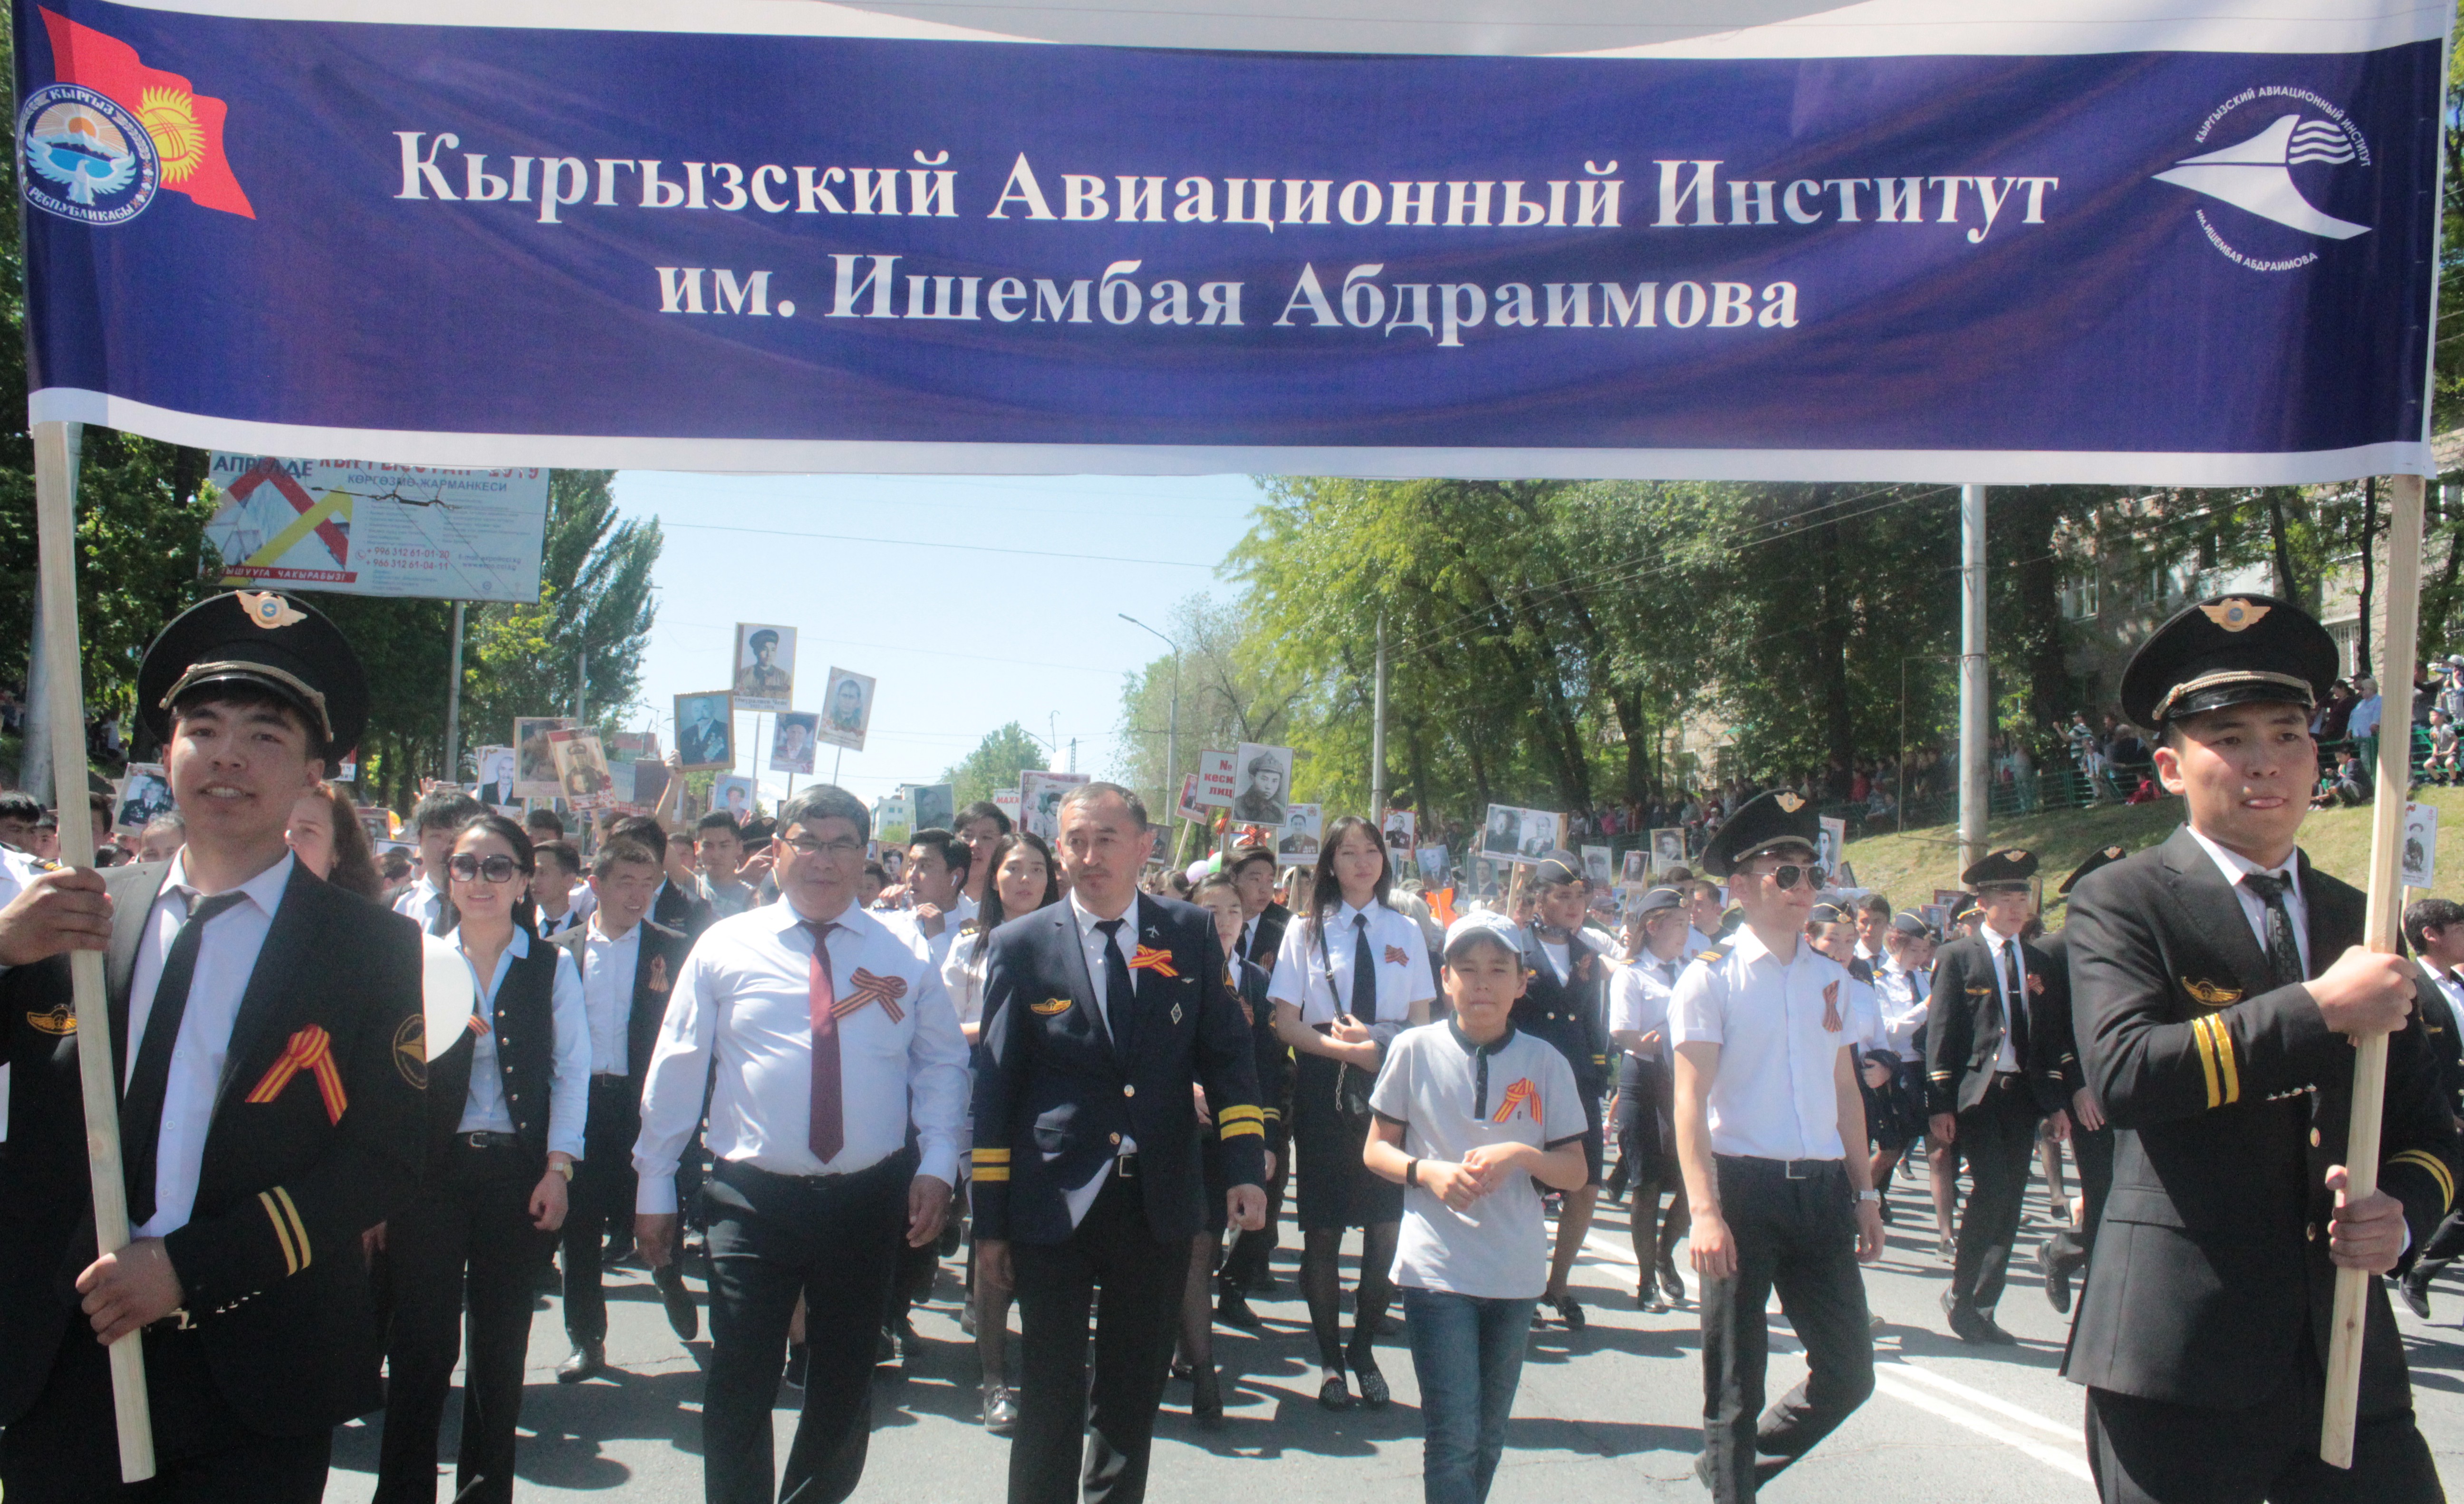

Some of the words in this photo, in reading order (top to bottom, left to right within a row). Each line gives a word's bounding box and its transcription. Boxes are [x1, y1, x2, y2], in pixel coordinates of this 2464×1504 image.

[49, 88, 115, 116] КЫРГЫЗ
[2194, 87, 2255, 143] КЫРГЫЗСКИЙ
[2258, 86, 2345, 121] АВИАЦИОННЫЙ
[2340, 118, 2371, 167] ИНСТИТУТ
[29, 187, 135, 222] РЕСПУБЛИКАСЫ
[393, 131, 959, 223] Кыргызский
[987, 152, 1624, 233] Авиационный
[1650, 160, 2059, 244] Институт
[2204, 224, 2243, 264] ИШЕМБАЯ
[2243, 252, 2318, 271] АБДРАИМОВА
[655, 266, 796, 318] им.
[824, 254, 1244, 325] Ишембая
[1273, 262, 1799, 347] Абдраимова
[375, 547, 390, 555] 996
[392, 548, 408, 557] 312
[391, 559, 407, 569] 312
[278, 569, 346, 581] ЧАКЫРАБЫЗ!
